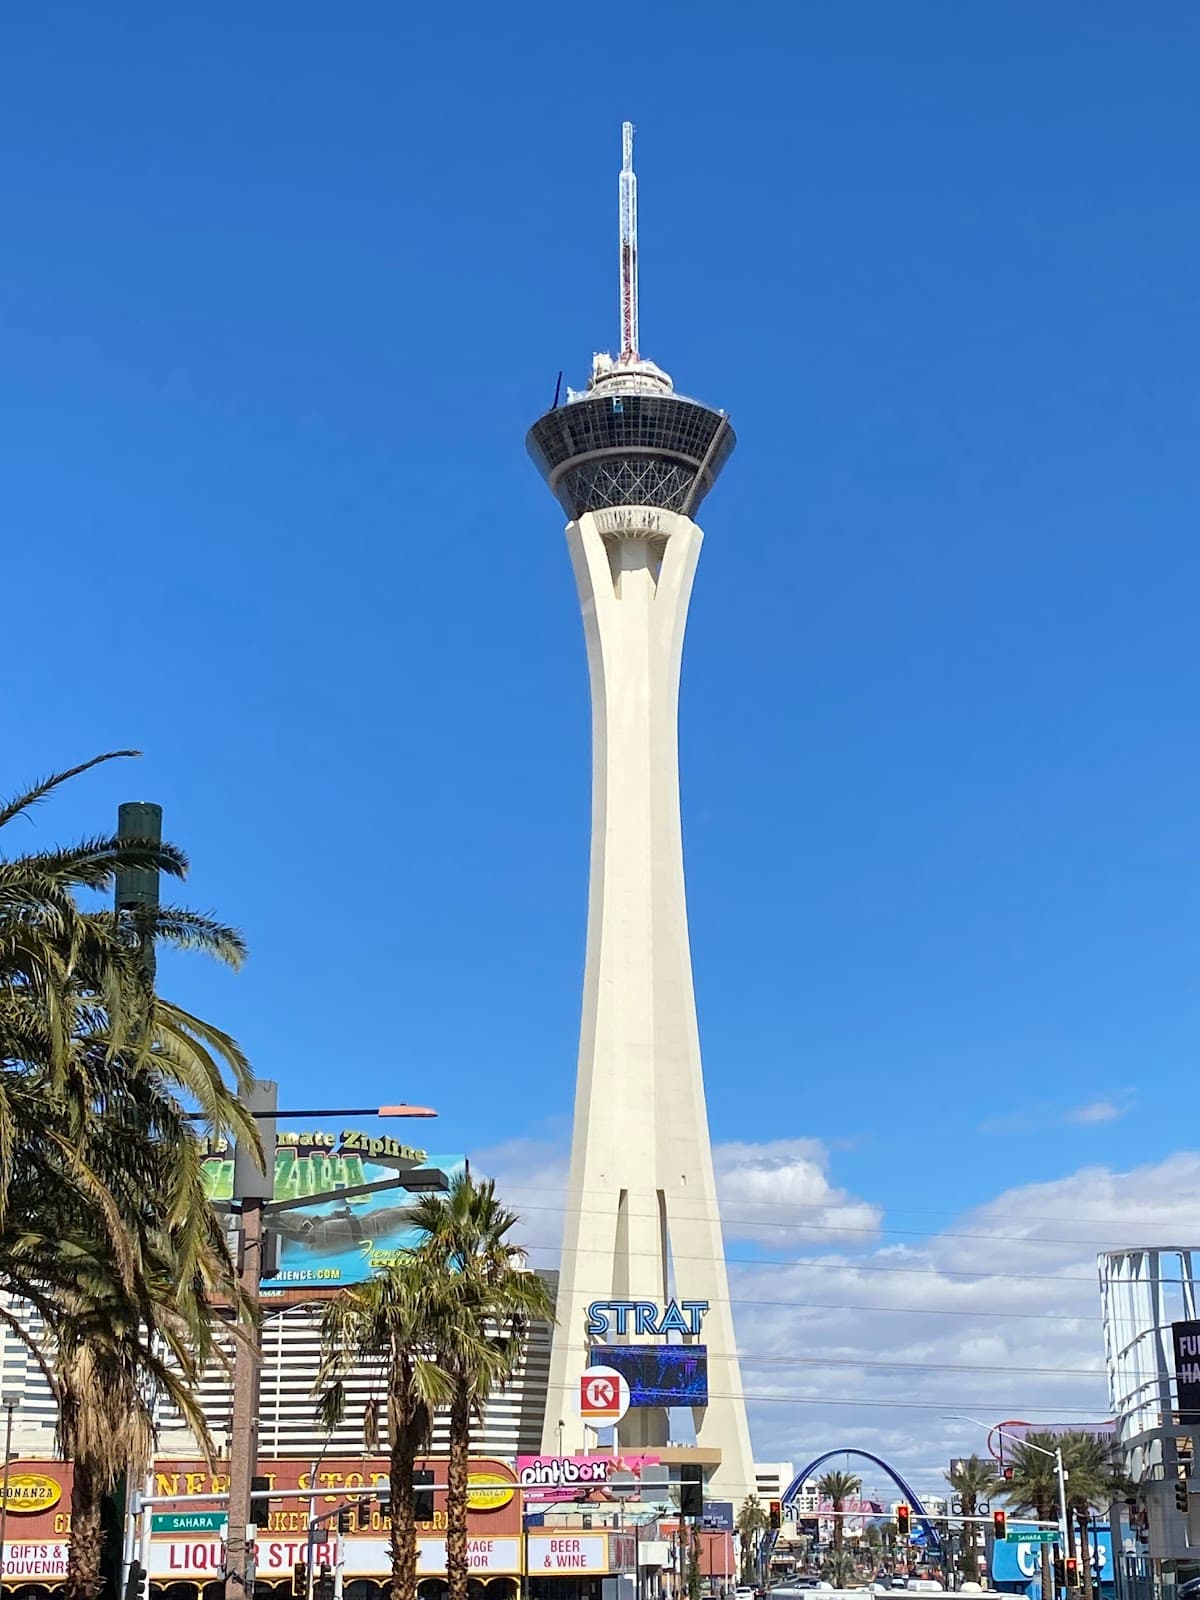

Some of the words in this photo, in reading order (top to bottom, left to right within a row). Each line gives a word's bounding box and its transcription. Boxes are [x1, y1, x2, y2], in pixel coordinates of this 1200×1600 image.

[278, 1132, 335, 1146] mate
[343, 1130, 427, 1161] Zipline
[588, 1298, 708, 1334] STRAT
[521, 1459, 607, 1487] pinkbox
[173, 1518, 213, 1527] SAHARA
[10, 1545, 48, 1559] GIFTS
[53, 1545, 62, 1558] &
[550, 1540, 580, 1552] BEER
[544, 1555, 552, 1568] &
[557, 1555, 587, 1567] WINE
